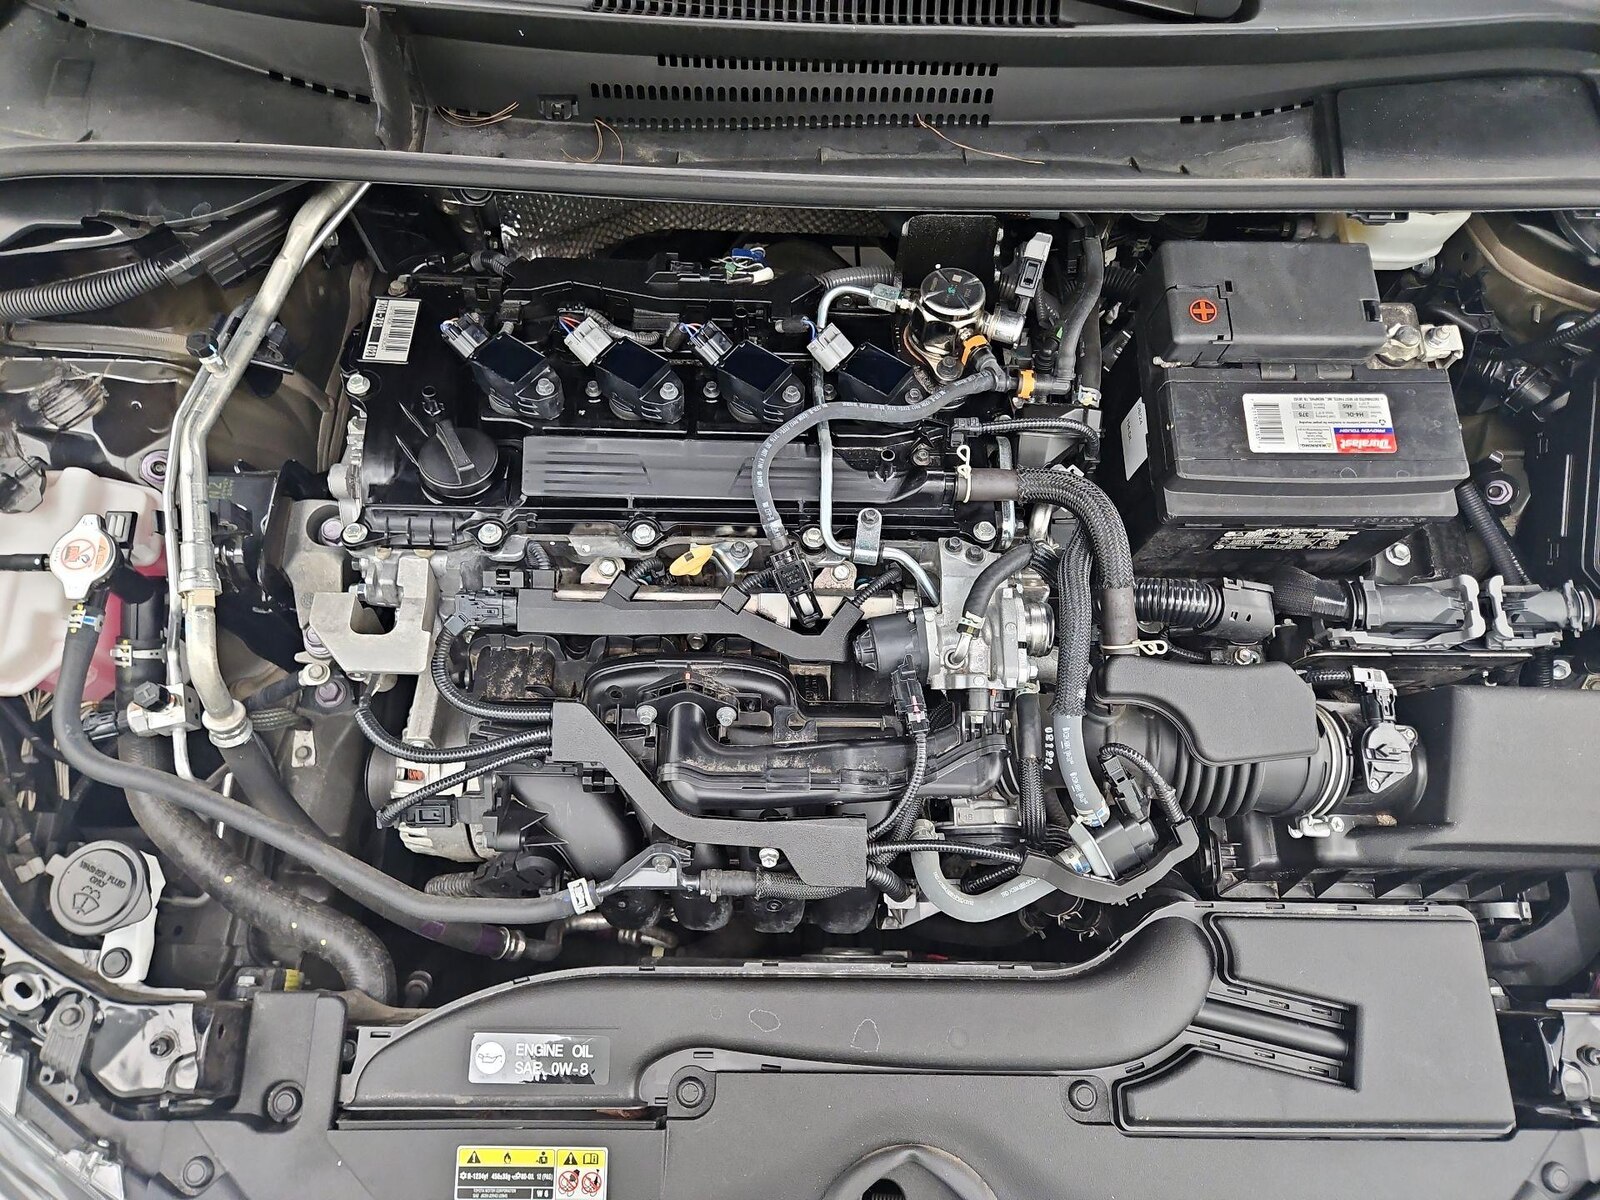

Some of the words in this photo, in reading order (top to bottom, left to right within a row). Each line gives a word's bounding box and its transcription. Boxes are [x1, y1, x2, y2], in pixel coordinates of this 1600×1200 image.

[1340, 439, 1391, 449] Duralast
[1044, 727, 1054, 770] 021224
[80, 860, 106, 878] WASHER
[108, 875, 127, 889] FLUID
[89, 876, 107, 888] ONLY
[515, 1043, 563, 1057] ENGINE
[572, 1044, 593, 1058] OIL
[551, 1063, 588, 1075] 0W-8
